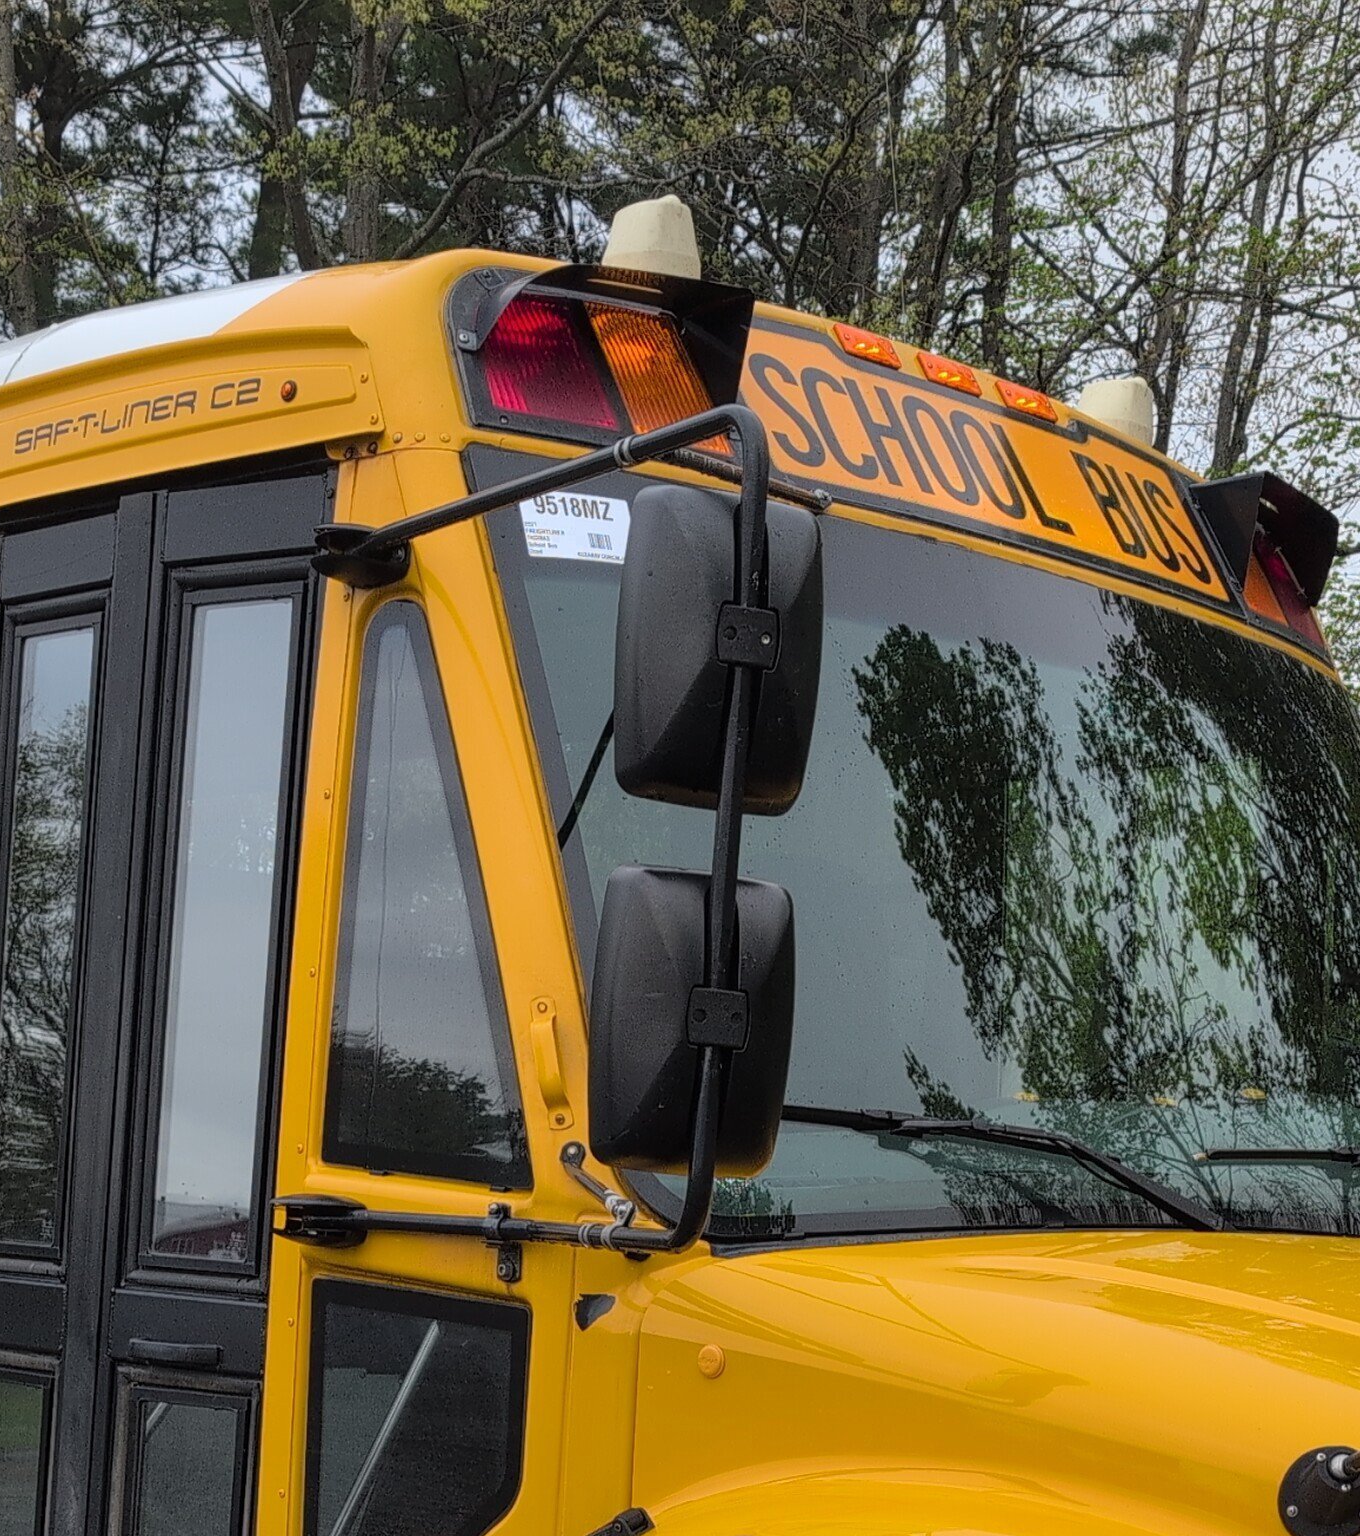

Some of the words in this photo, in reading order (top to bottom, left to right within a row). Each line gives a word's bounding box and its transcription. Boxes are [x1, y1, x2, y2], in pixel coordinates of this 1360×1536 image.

[209, 377, 261, 410] C2
[747, 352, 1071, 536] SCHOOL
[1071, 449, 1214, 585] BUS
[533, 494, 614, 522] 9518MZ
